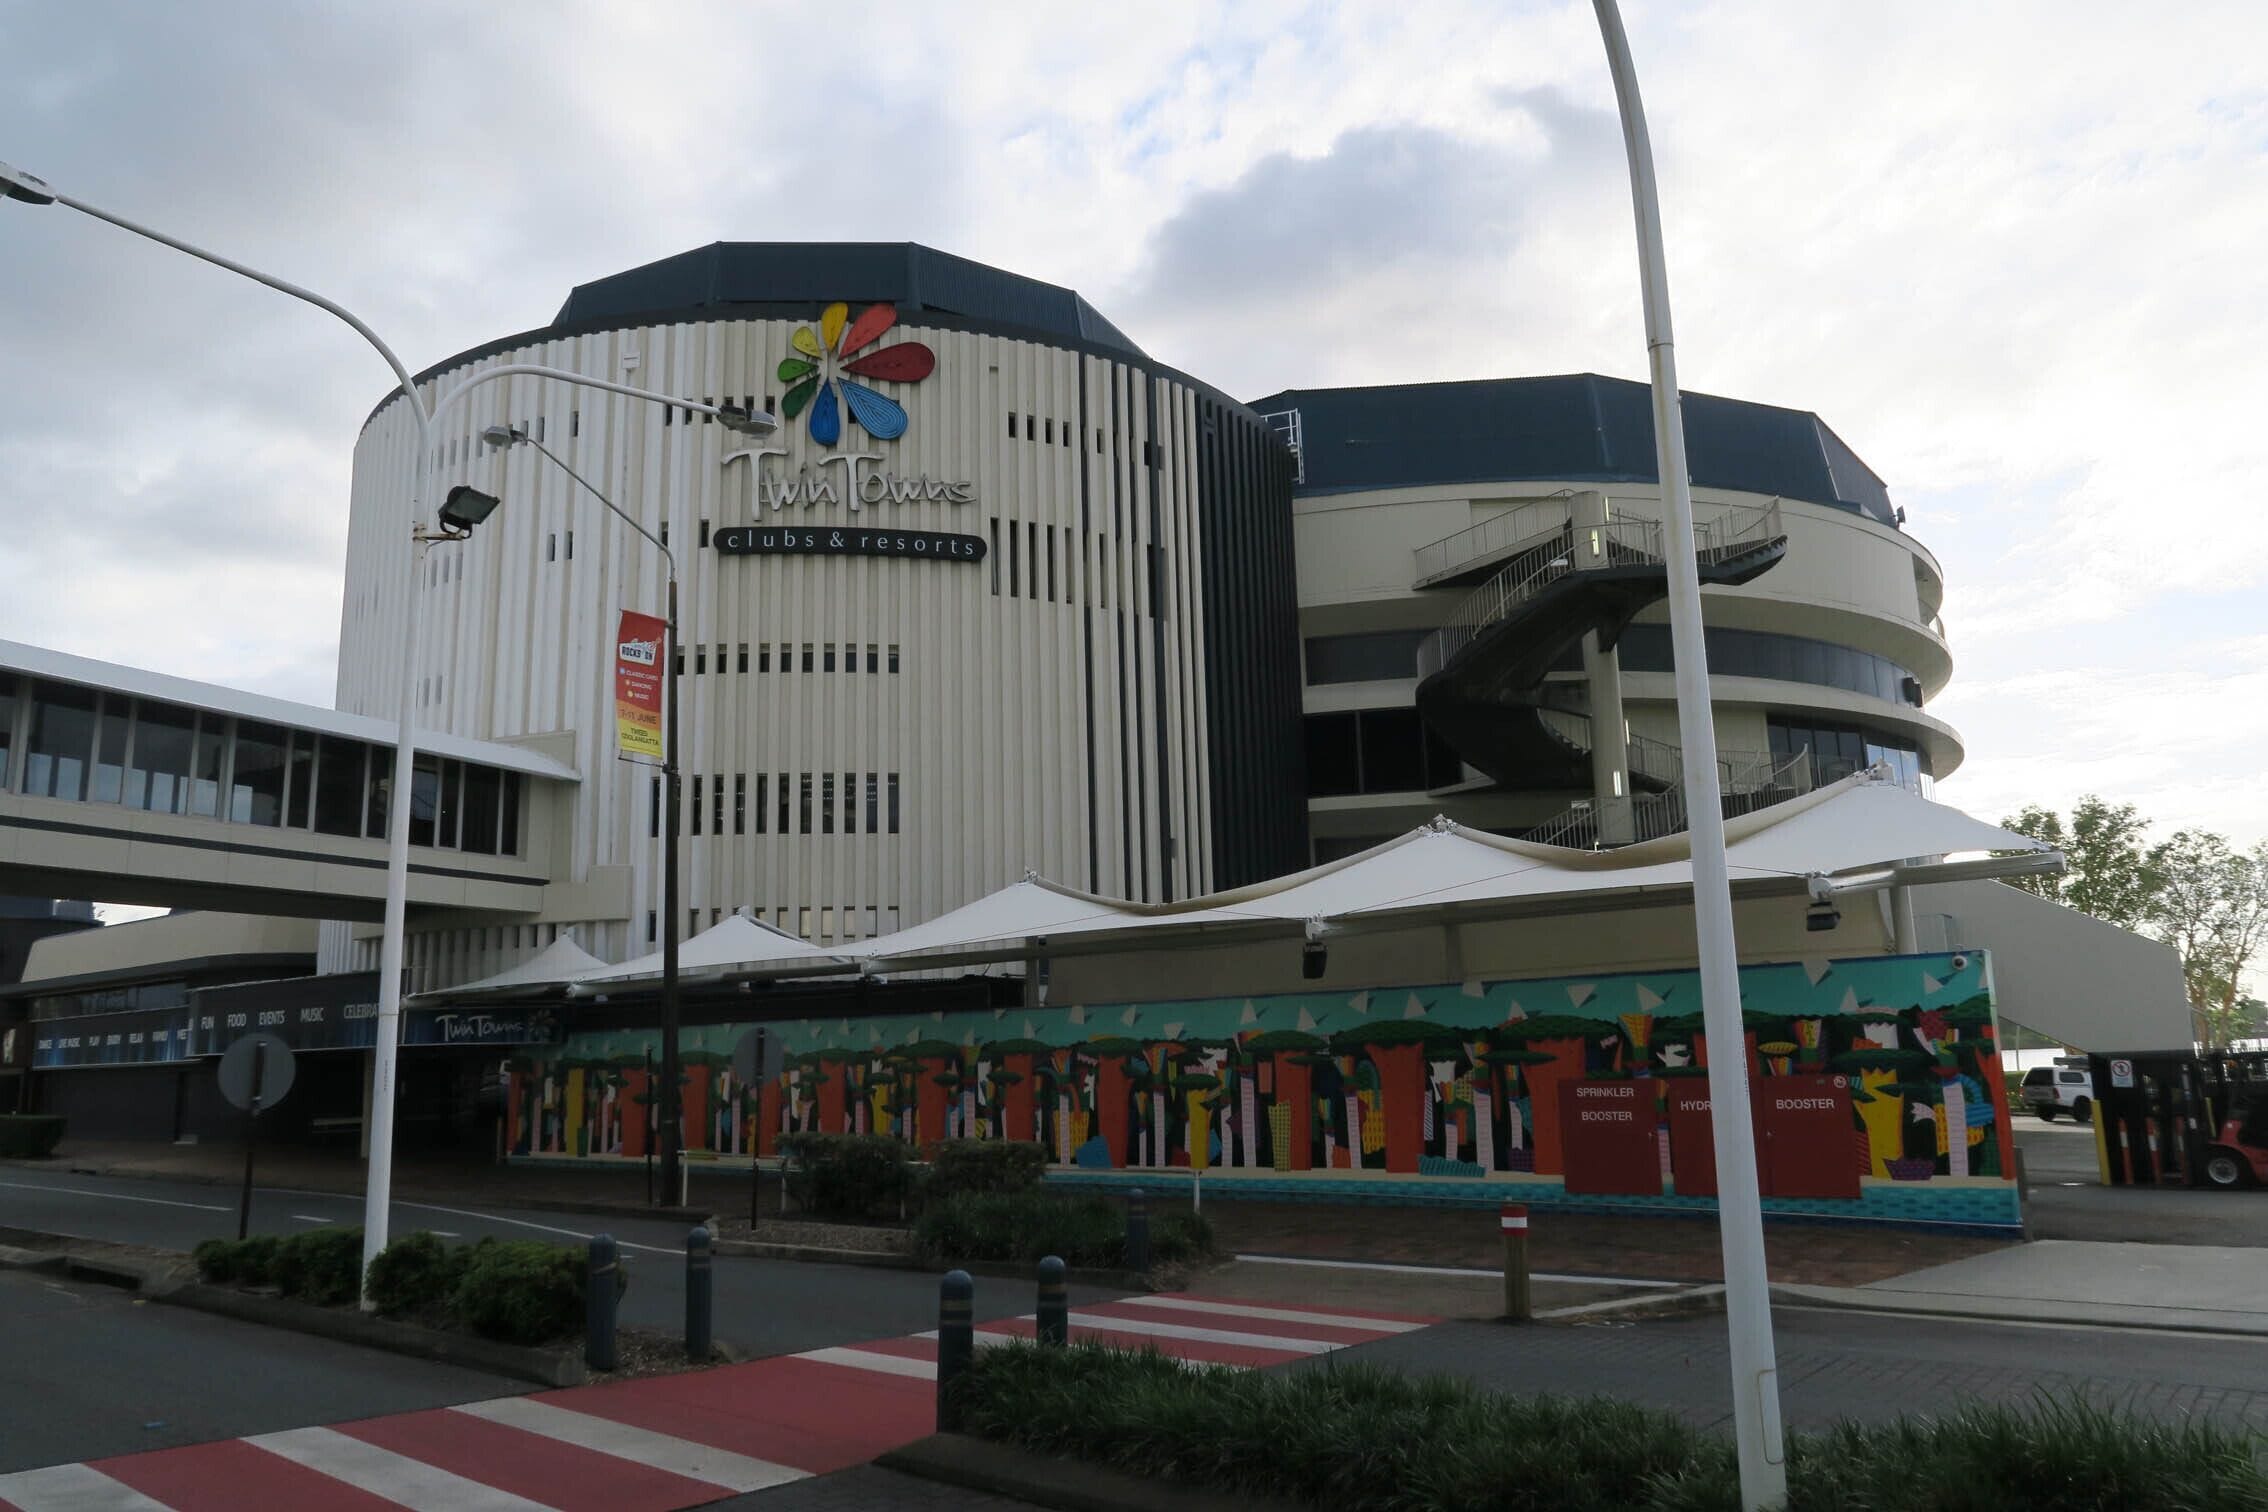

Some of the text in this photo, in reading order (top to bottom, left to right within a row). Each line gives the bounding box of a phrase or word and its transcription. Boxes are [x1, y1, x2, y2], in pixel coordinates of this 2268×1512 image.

[720, 449, 977, 522] Twin Towns
[727, 529, 975, 556] clubs & resorts
[622, 646, 641, 658] ROCKS
[637, 713, 657, 725] JUNE
[201, 1015, 215, 1031] FUN
[226, 1012, 247, 1028] FOOD
[258, 1010, 286, 1025] EVENTS
[299, 1007, 325, 1023] MUSIC
[343, 1003, 378, 1019] CELEBRA
[434, 1013, 525, 1042] Twin Towns
[1576, 1086, 1635, 1098] SPRINKLER
[1680, 1098, 1835, 1112] HYDR BOOSTER
[1581, 1110, 1633, 1121] BOOSTER
